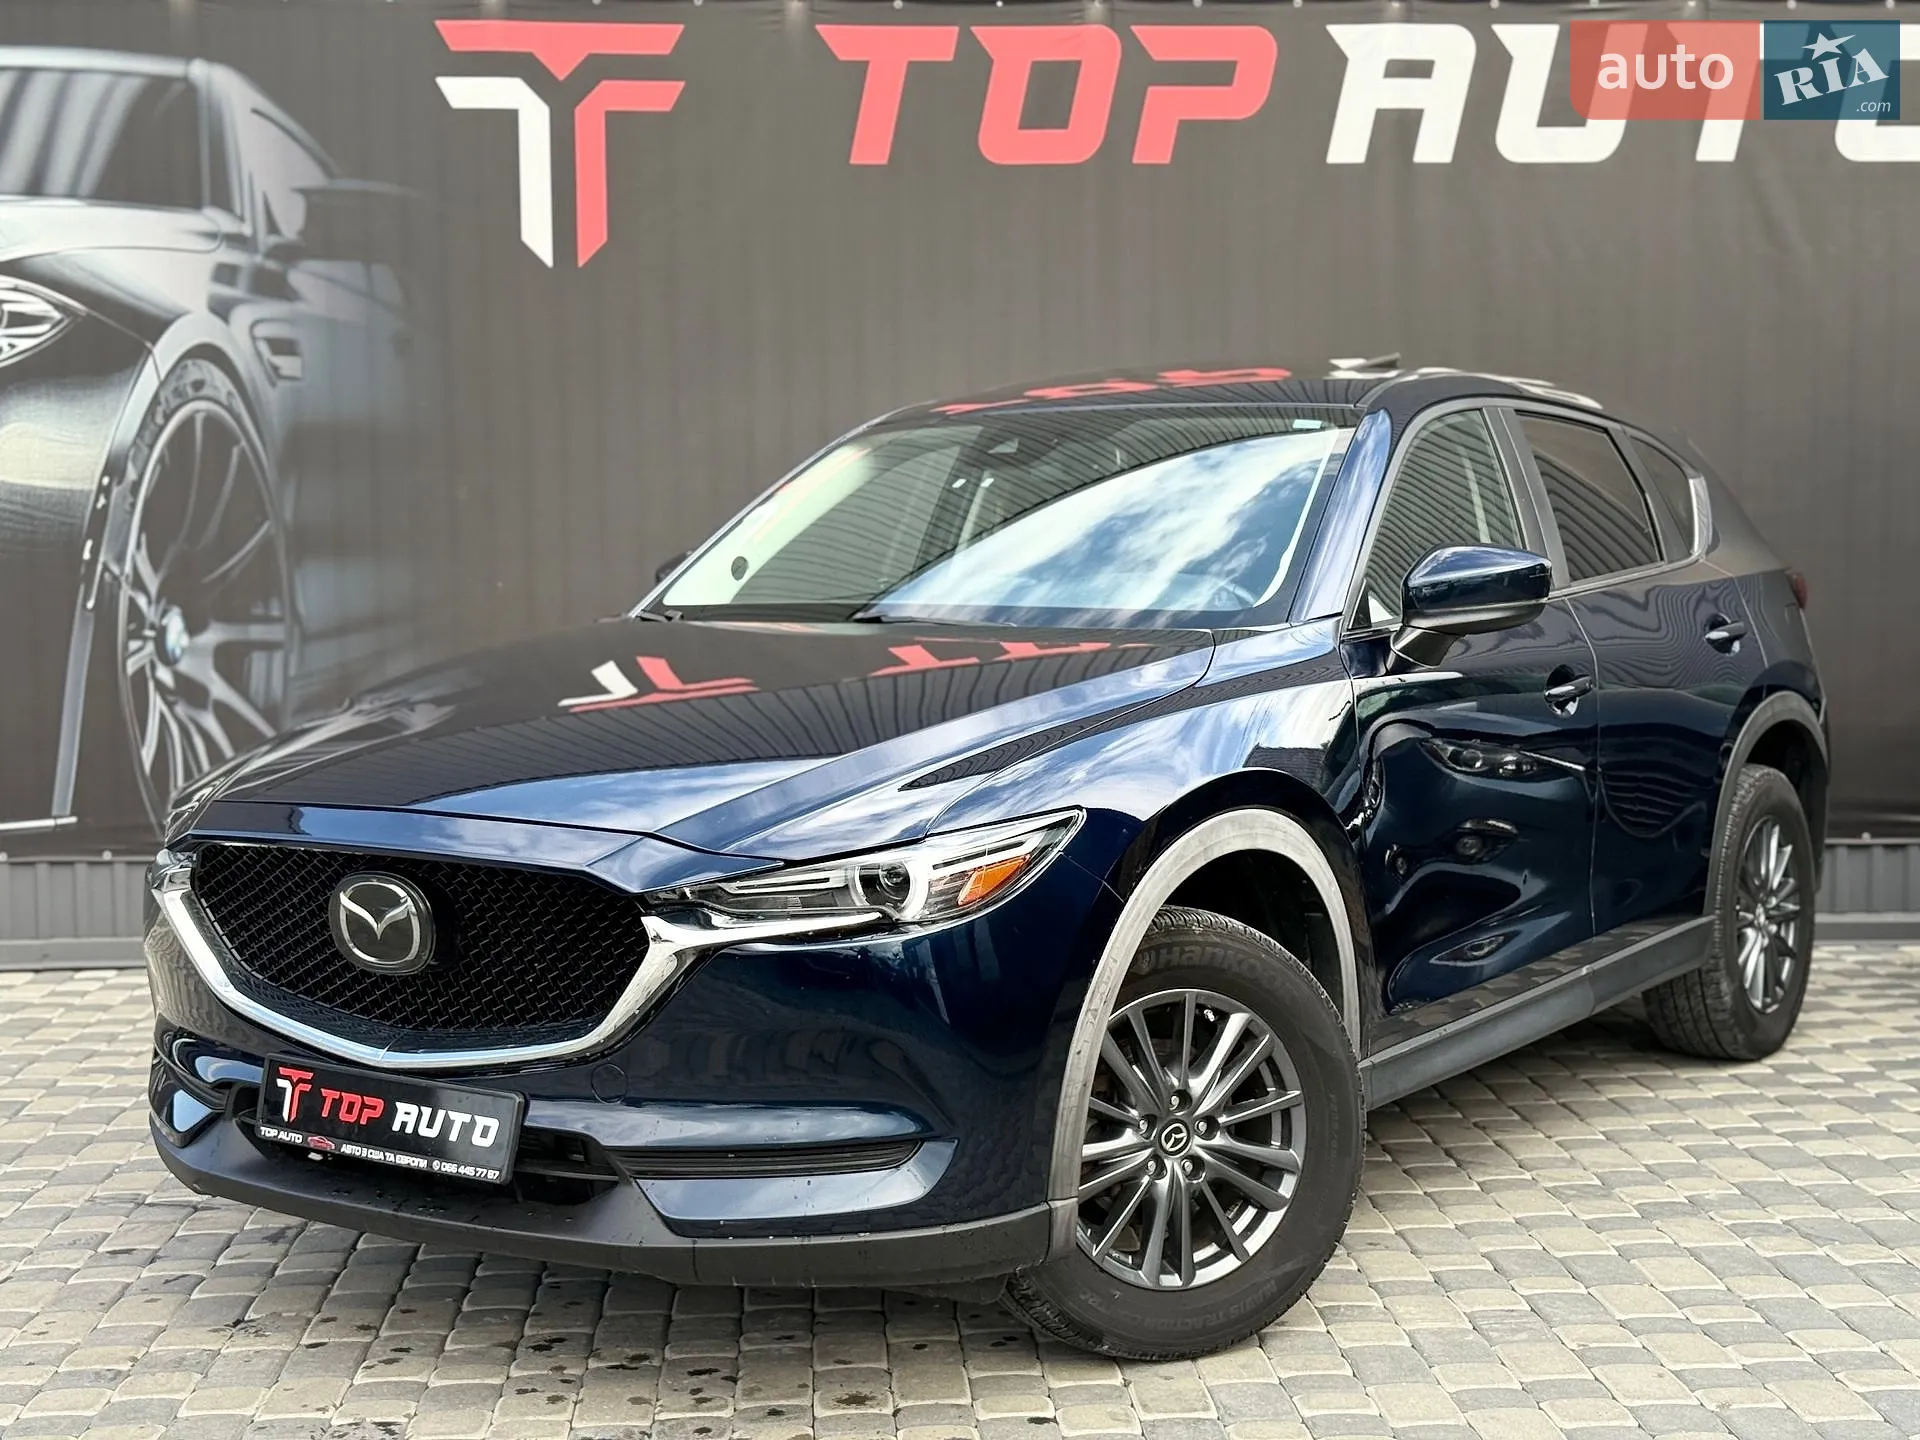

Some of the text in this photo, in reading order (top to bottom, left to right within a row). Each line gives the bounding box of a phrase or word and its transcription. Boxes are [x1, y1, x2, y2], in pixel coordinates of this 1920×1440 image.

[815, 24, 1278, 164] TOP
[260, 1127, 303, 1144] TOP AUTO
[320, 1088, 500, 1148] TOP AUTO
